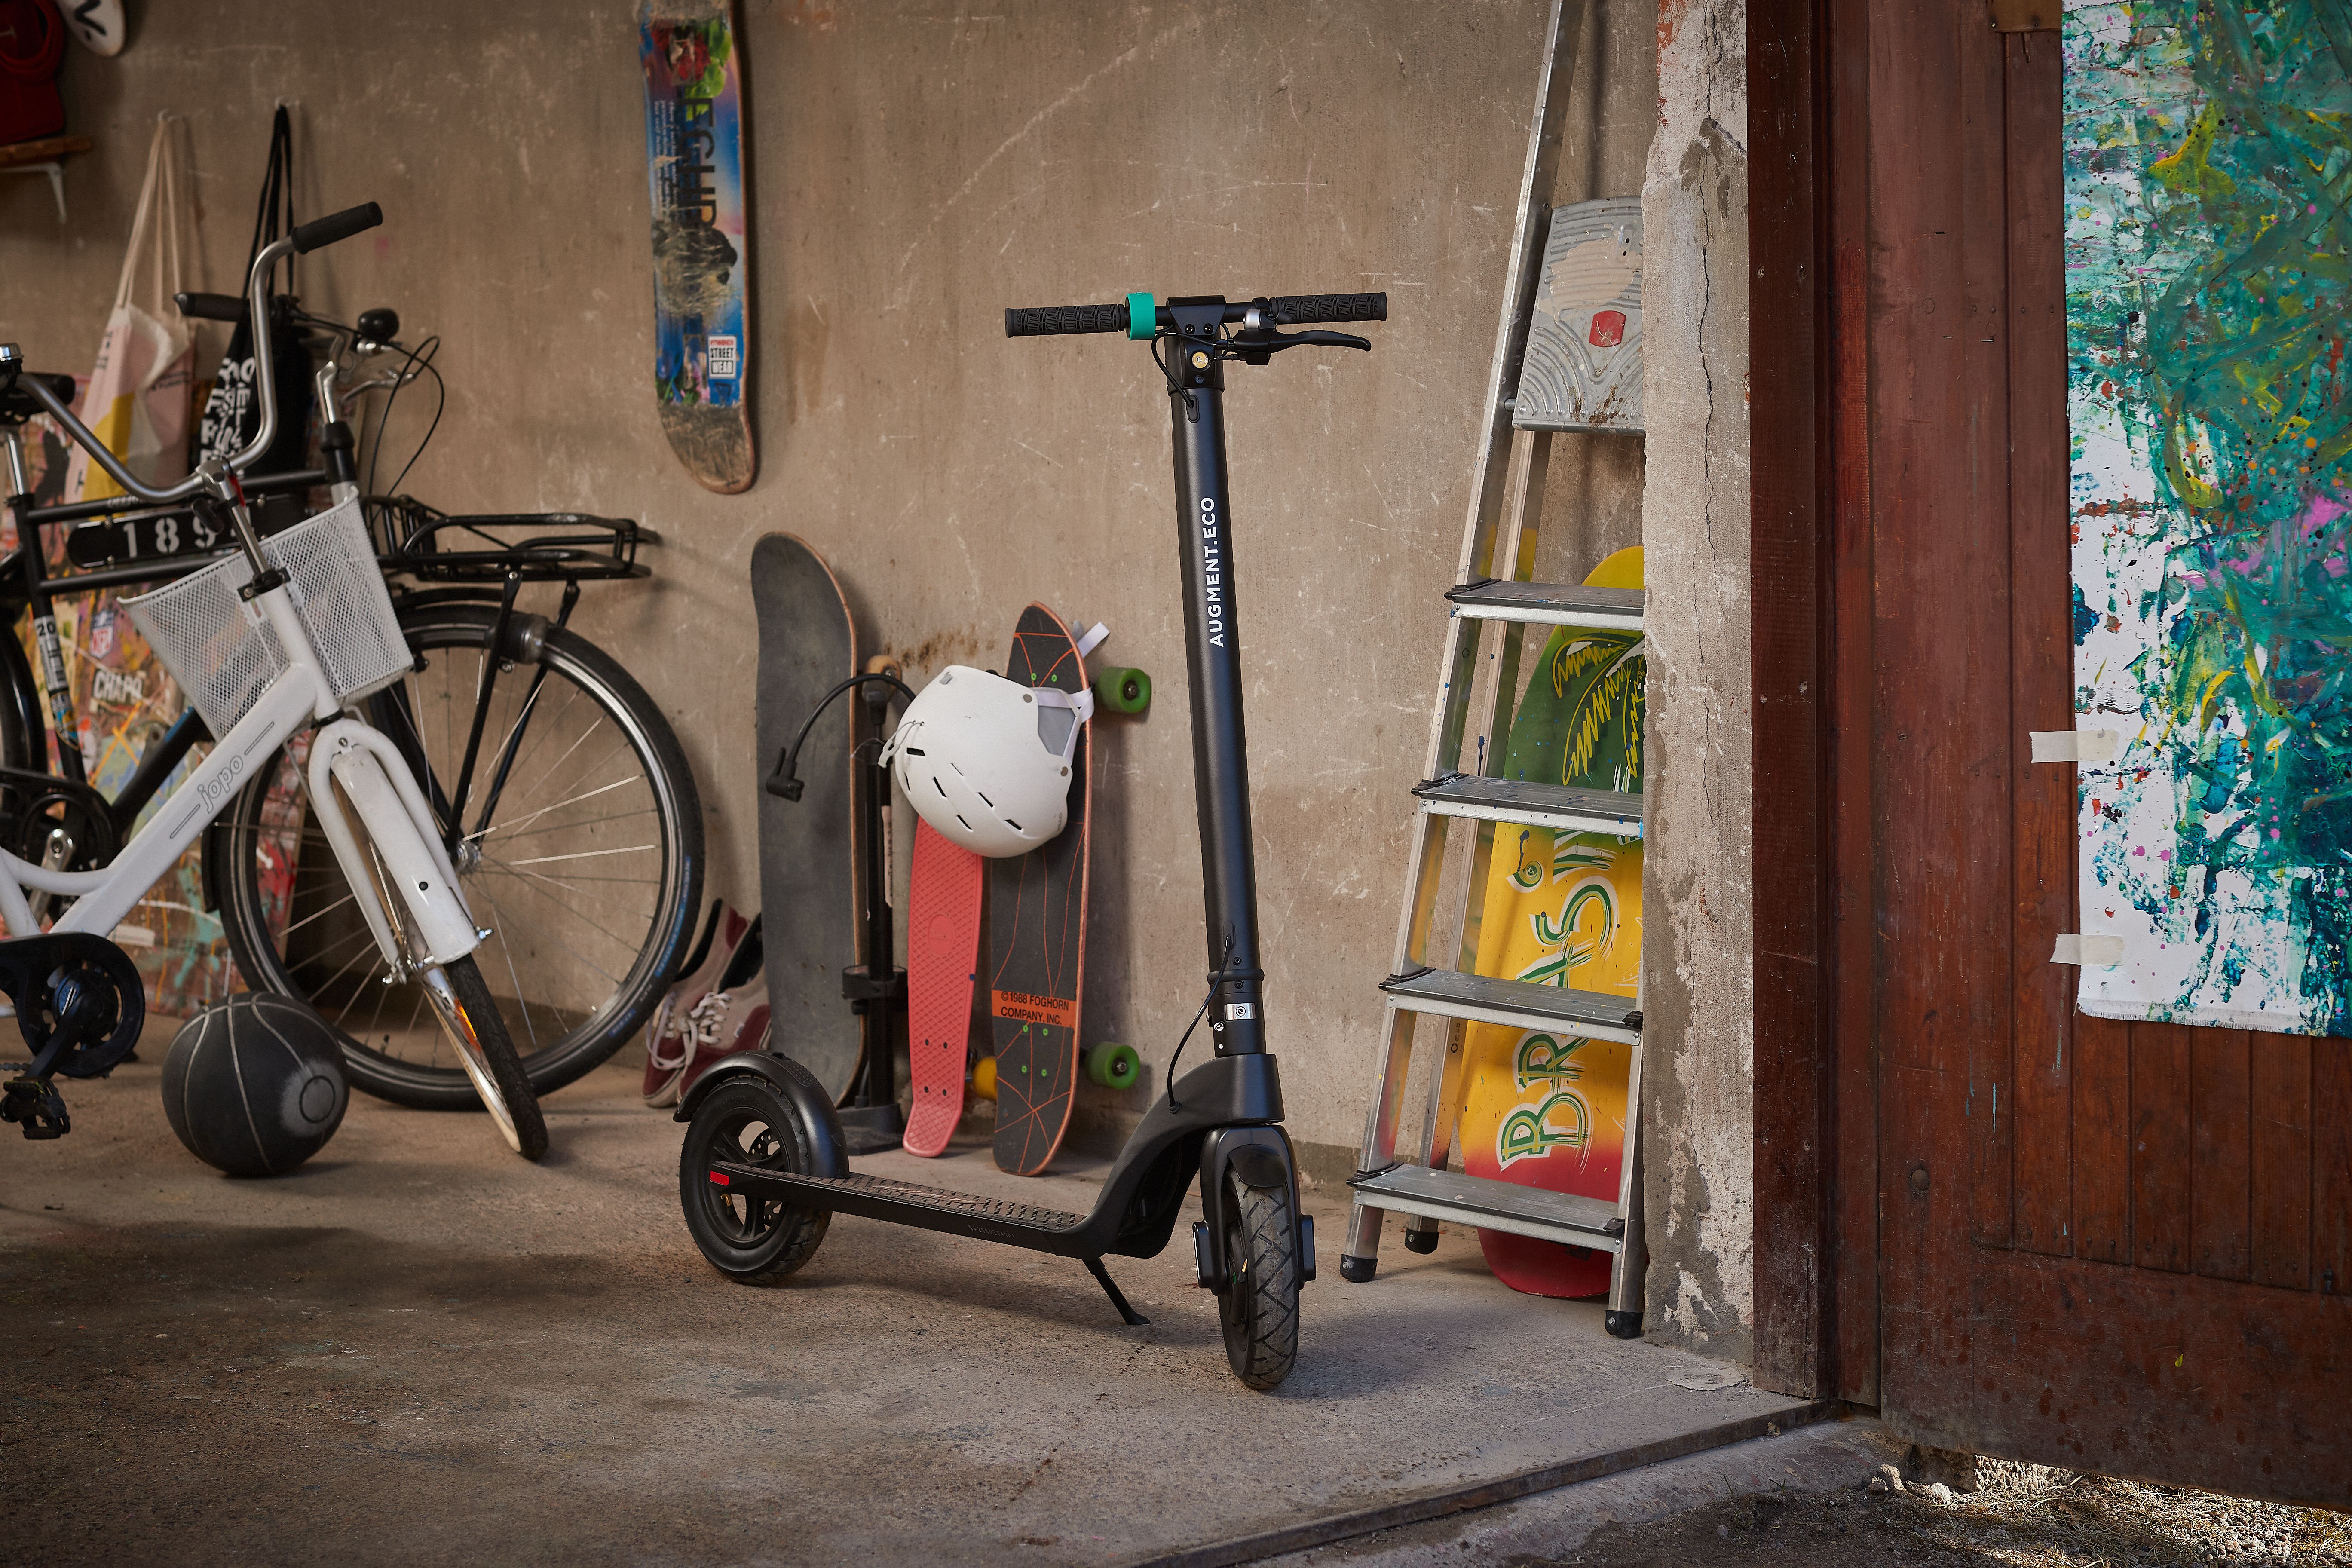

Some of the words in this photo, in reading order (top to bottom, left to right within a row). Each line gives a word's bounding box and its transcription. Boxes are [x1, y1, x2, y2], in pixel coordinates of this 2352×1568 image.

[711, 348, 733, 358] STREET
[1200, 497, 1224, 647] AUGMENT.ECO
[197, 754, 244, 815] jopo
[1029, 995, 1069, 1011] FOGHORN
[1047, 1014, 1062, 1025] INC.
